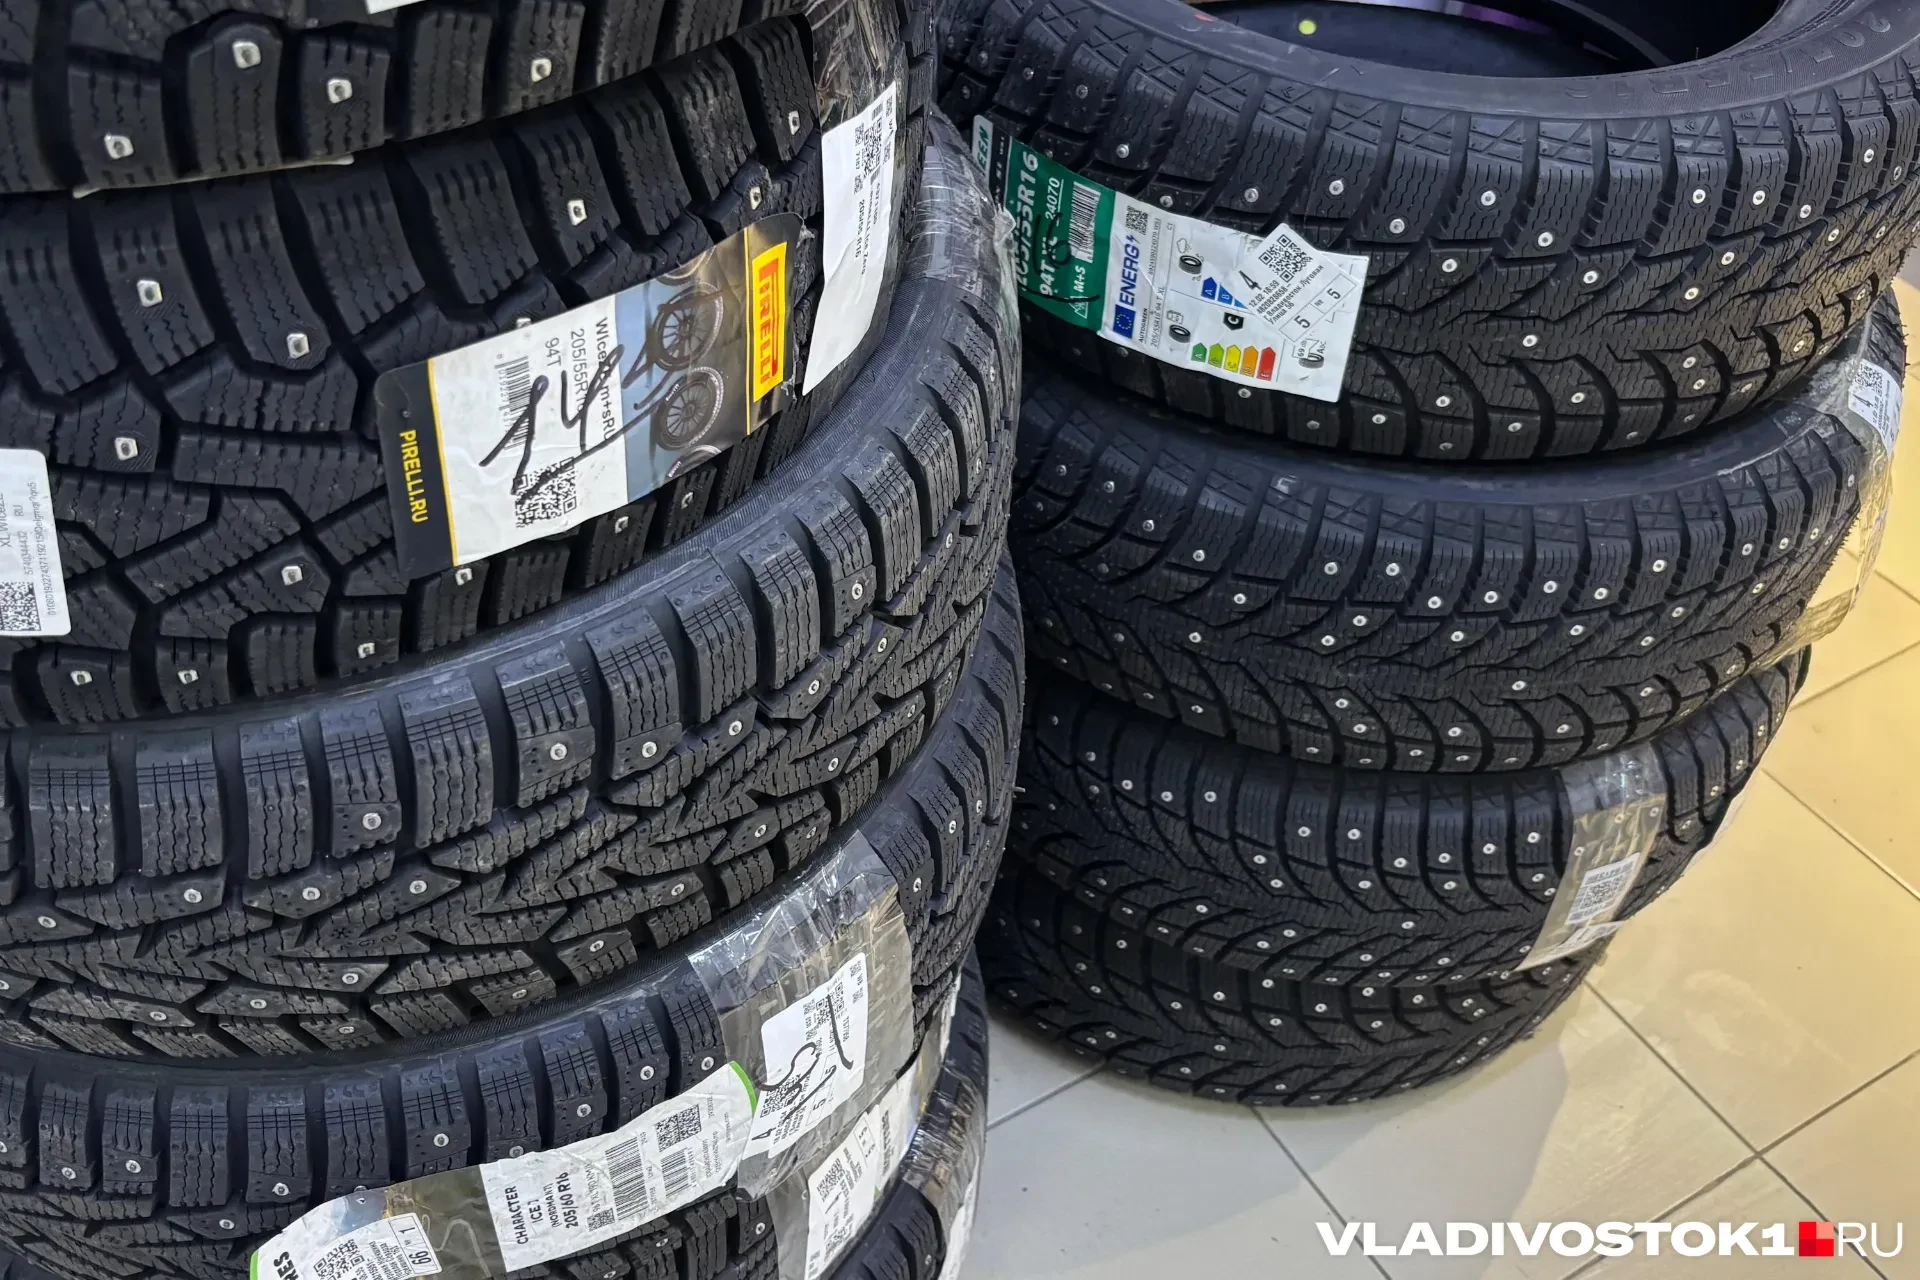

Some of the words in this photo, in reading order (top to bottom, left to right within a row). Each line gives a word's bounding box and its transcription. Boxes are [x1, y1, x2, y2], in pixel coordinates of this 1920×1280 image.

[1044, 177, 1060, 221] 24070
[854, 237, 862, 258] R16
[1072, 265, 1086, 293] M+S
[1119, 243, 1140, 307] ENERG
[1239, 270, 1263, 291] 4
[1249, 293, 1265, 308] 12.02
[1263, 280, 1280, 295] 18:59
[1266, 287, 1301, 316] Владивосток
[1300, 265, 1325, 288] Луговая
[757, 258, 779, 385] PIRELLI
[1269, 307, 1288, 325] Улица
[1294, 315, 1311, 329] 5
[1326, 288, 1341, 300] 5
[1138, 308, 1148, 343] AUTOGREEN
[545, 337, 562, 367] 94T
[399, 429, 429, 523] PIRELLI.RU
[13, 505, 23, 517] RU
[812, 1099, 826, 1111] 5
[556, 1172, 572, 1193] R16
[504, 1185, 529, 1245] CHARACTER
[529, 1206, 544, 1224] ICE
[560, 1194, 580, 1229] 205/60
[398, 1226, 416, 1235] 1
[408, 1250, 432, 1265] 66
